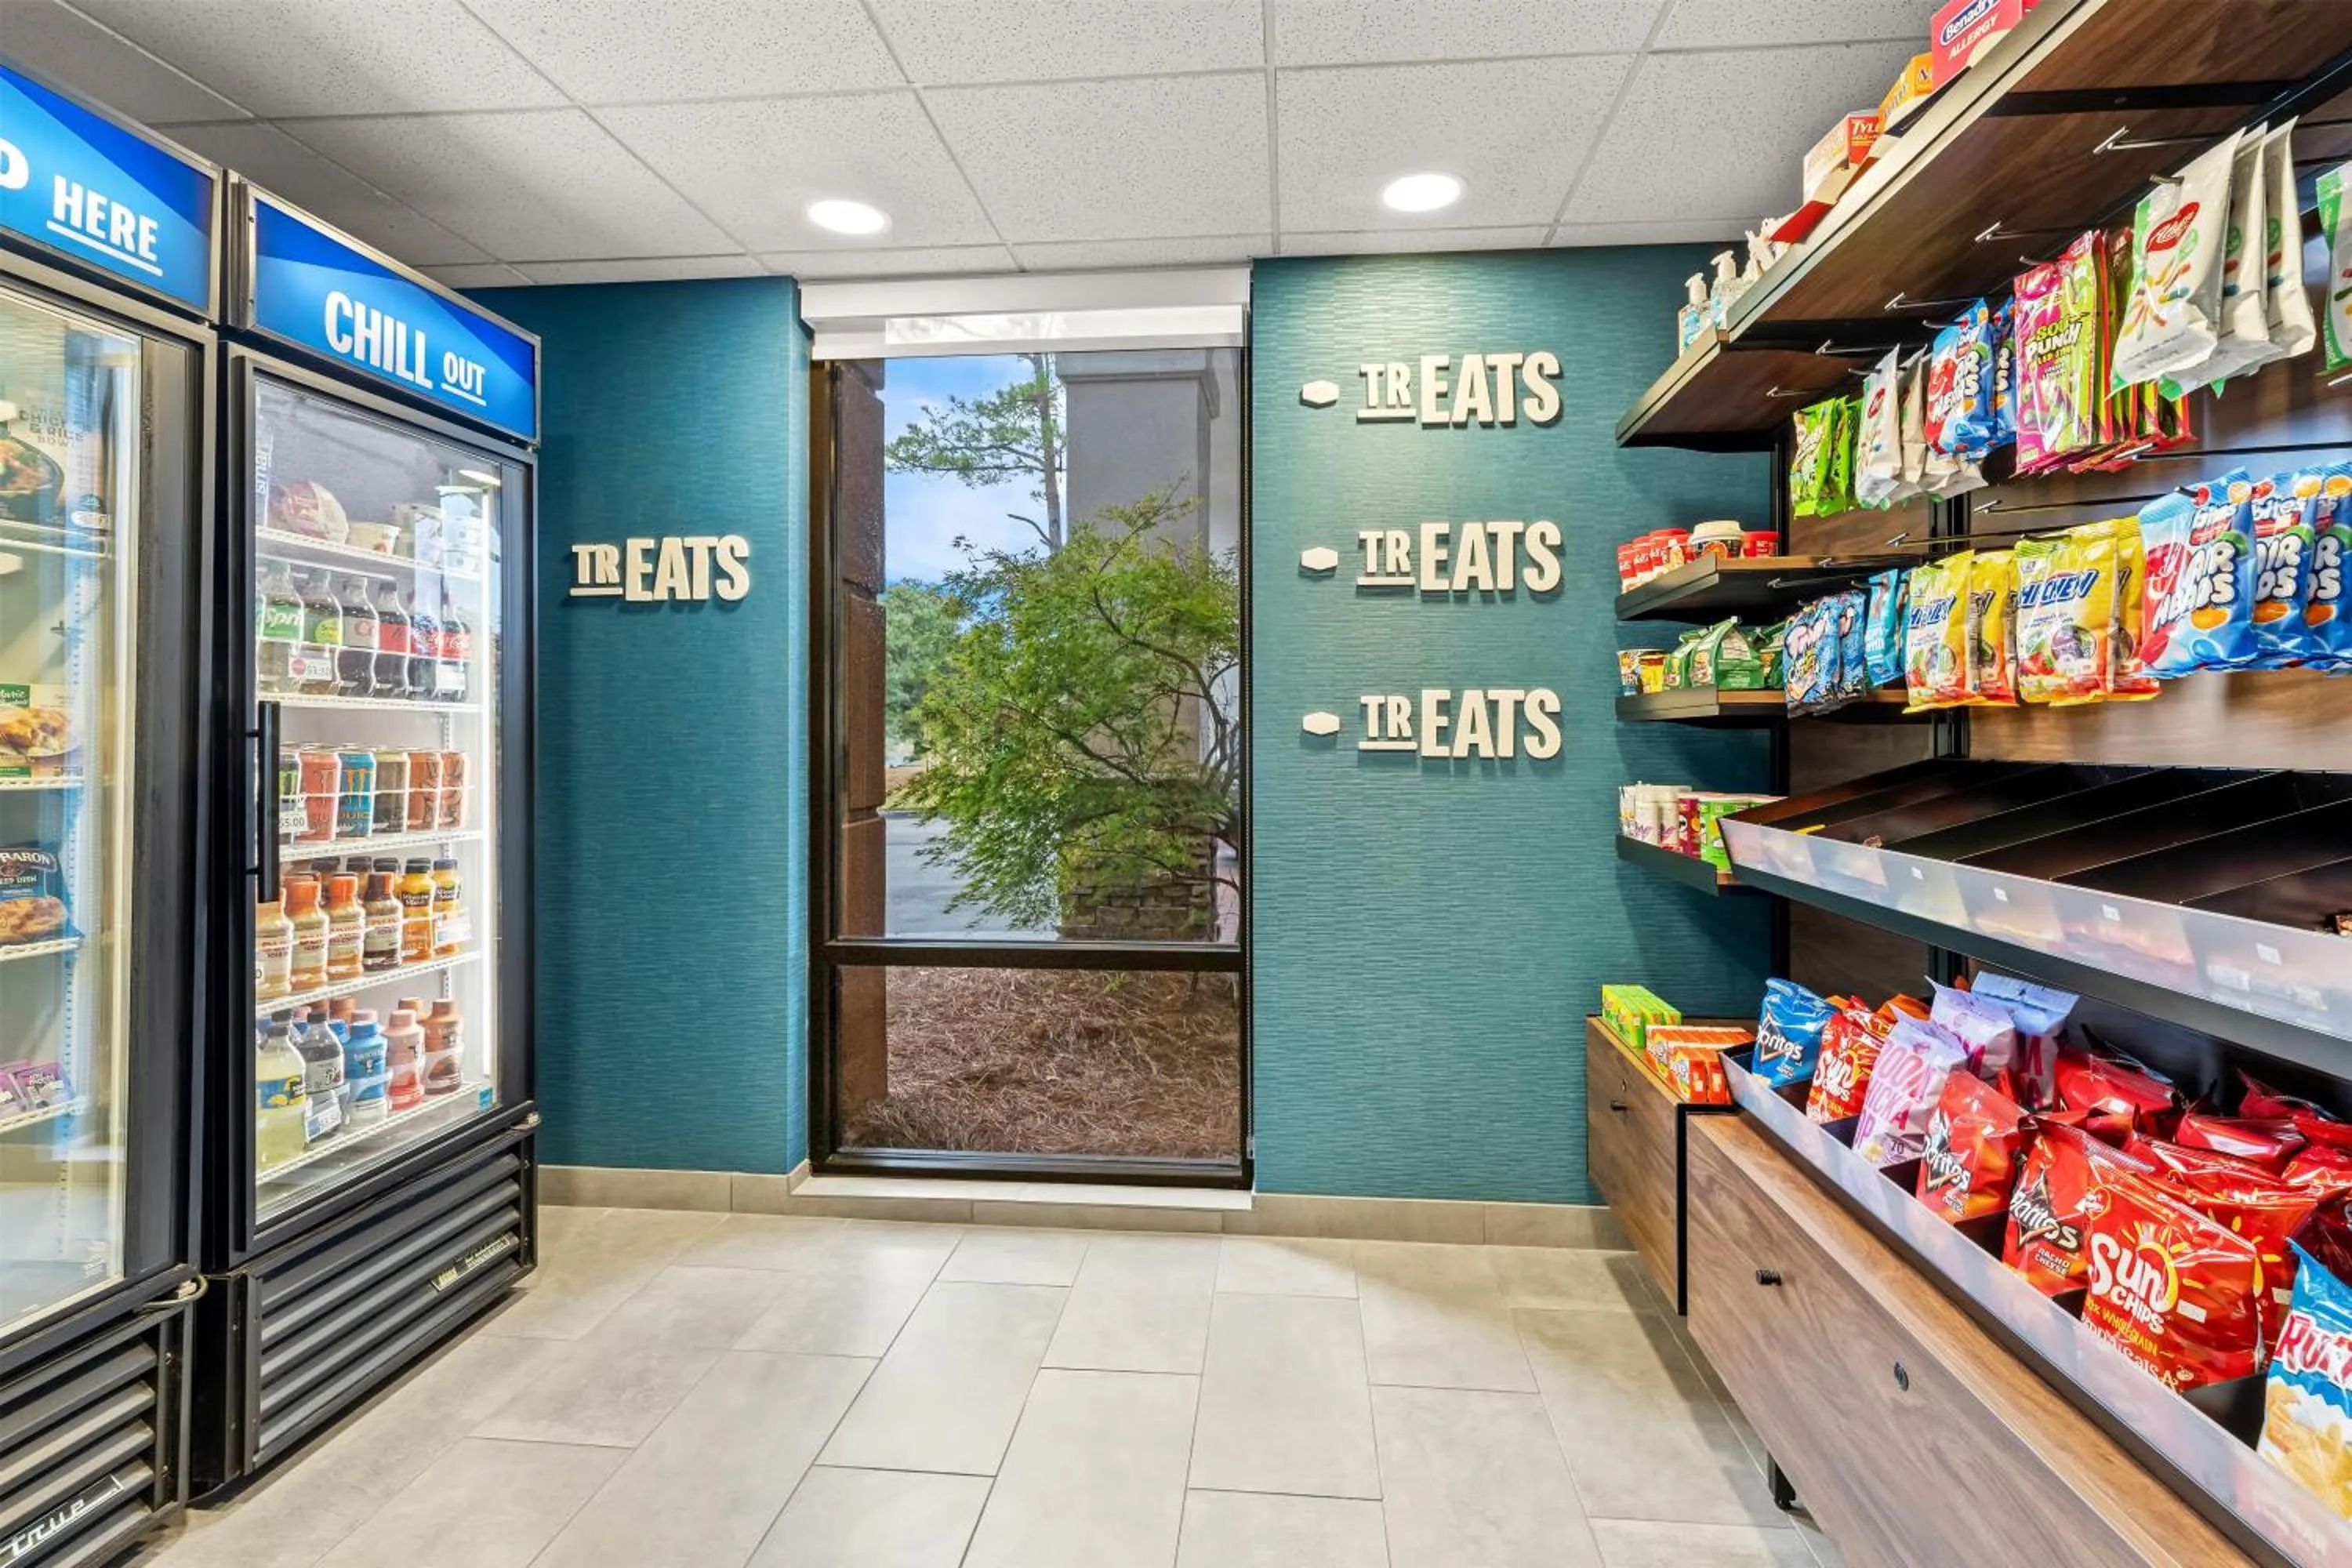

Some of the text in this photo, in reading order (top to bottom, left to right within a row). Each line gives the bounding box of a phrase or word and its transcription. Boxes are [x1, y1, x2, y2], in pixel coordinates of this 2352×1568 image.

[1948, 13, 1998, 60] ALLERGY
[50, 175, 161, 272] HERE
[325, 291, 487, 402] CHILL OUT
[1357, 352, 1561, 423] TREATS
[570, 535, 750, 601] TREATS
[1357, 521, 1561, 592] TREATS
[1358, 688, 1562, 759] TREATS
[2009, 1189, 2078, 1250] Doritos
[2088, 1232, 2178, 1313] Sun
[2110, 1286, 2164, 1334] CHIPS
